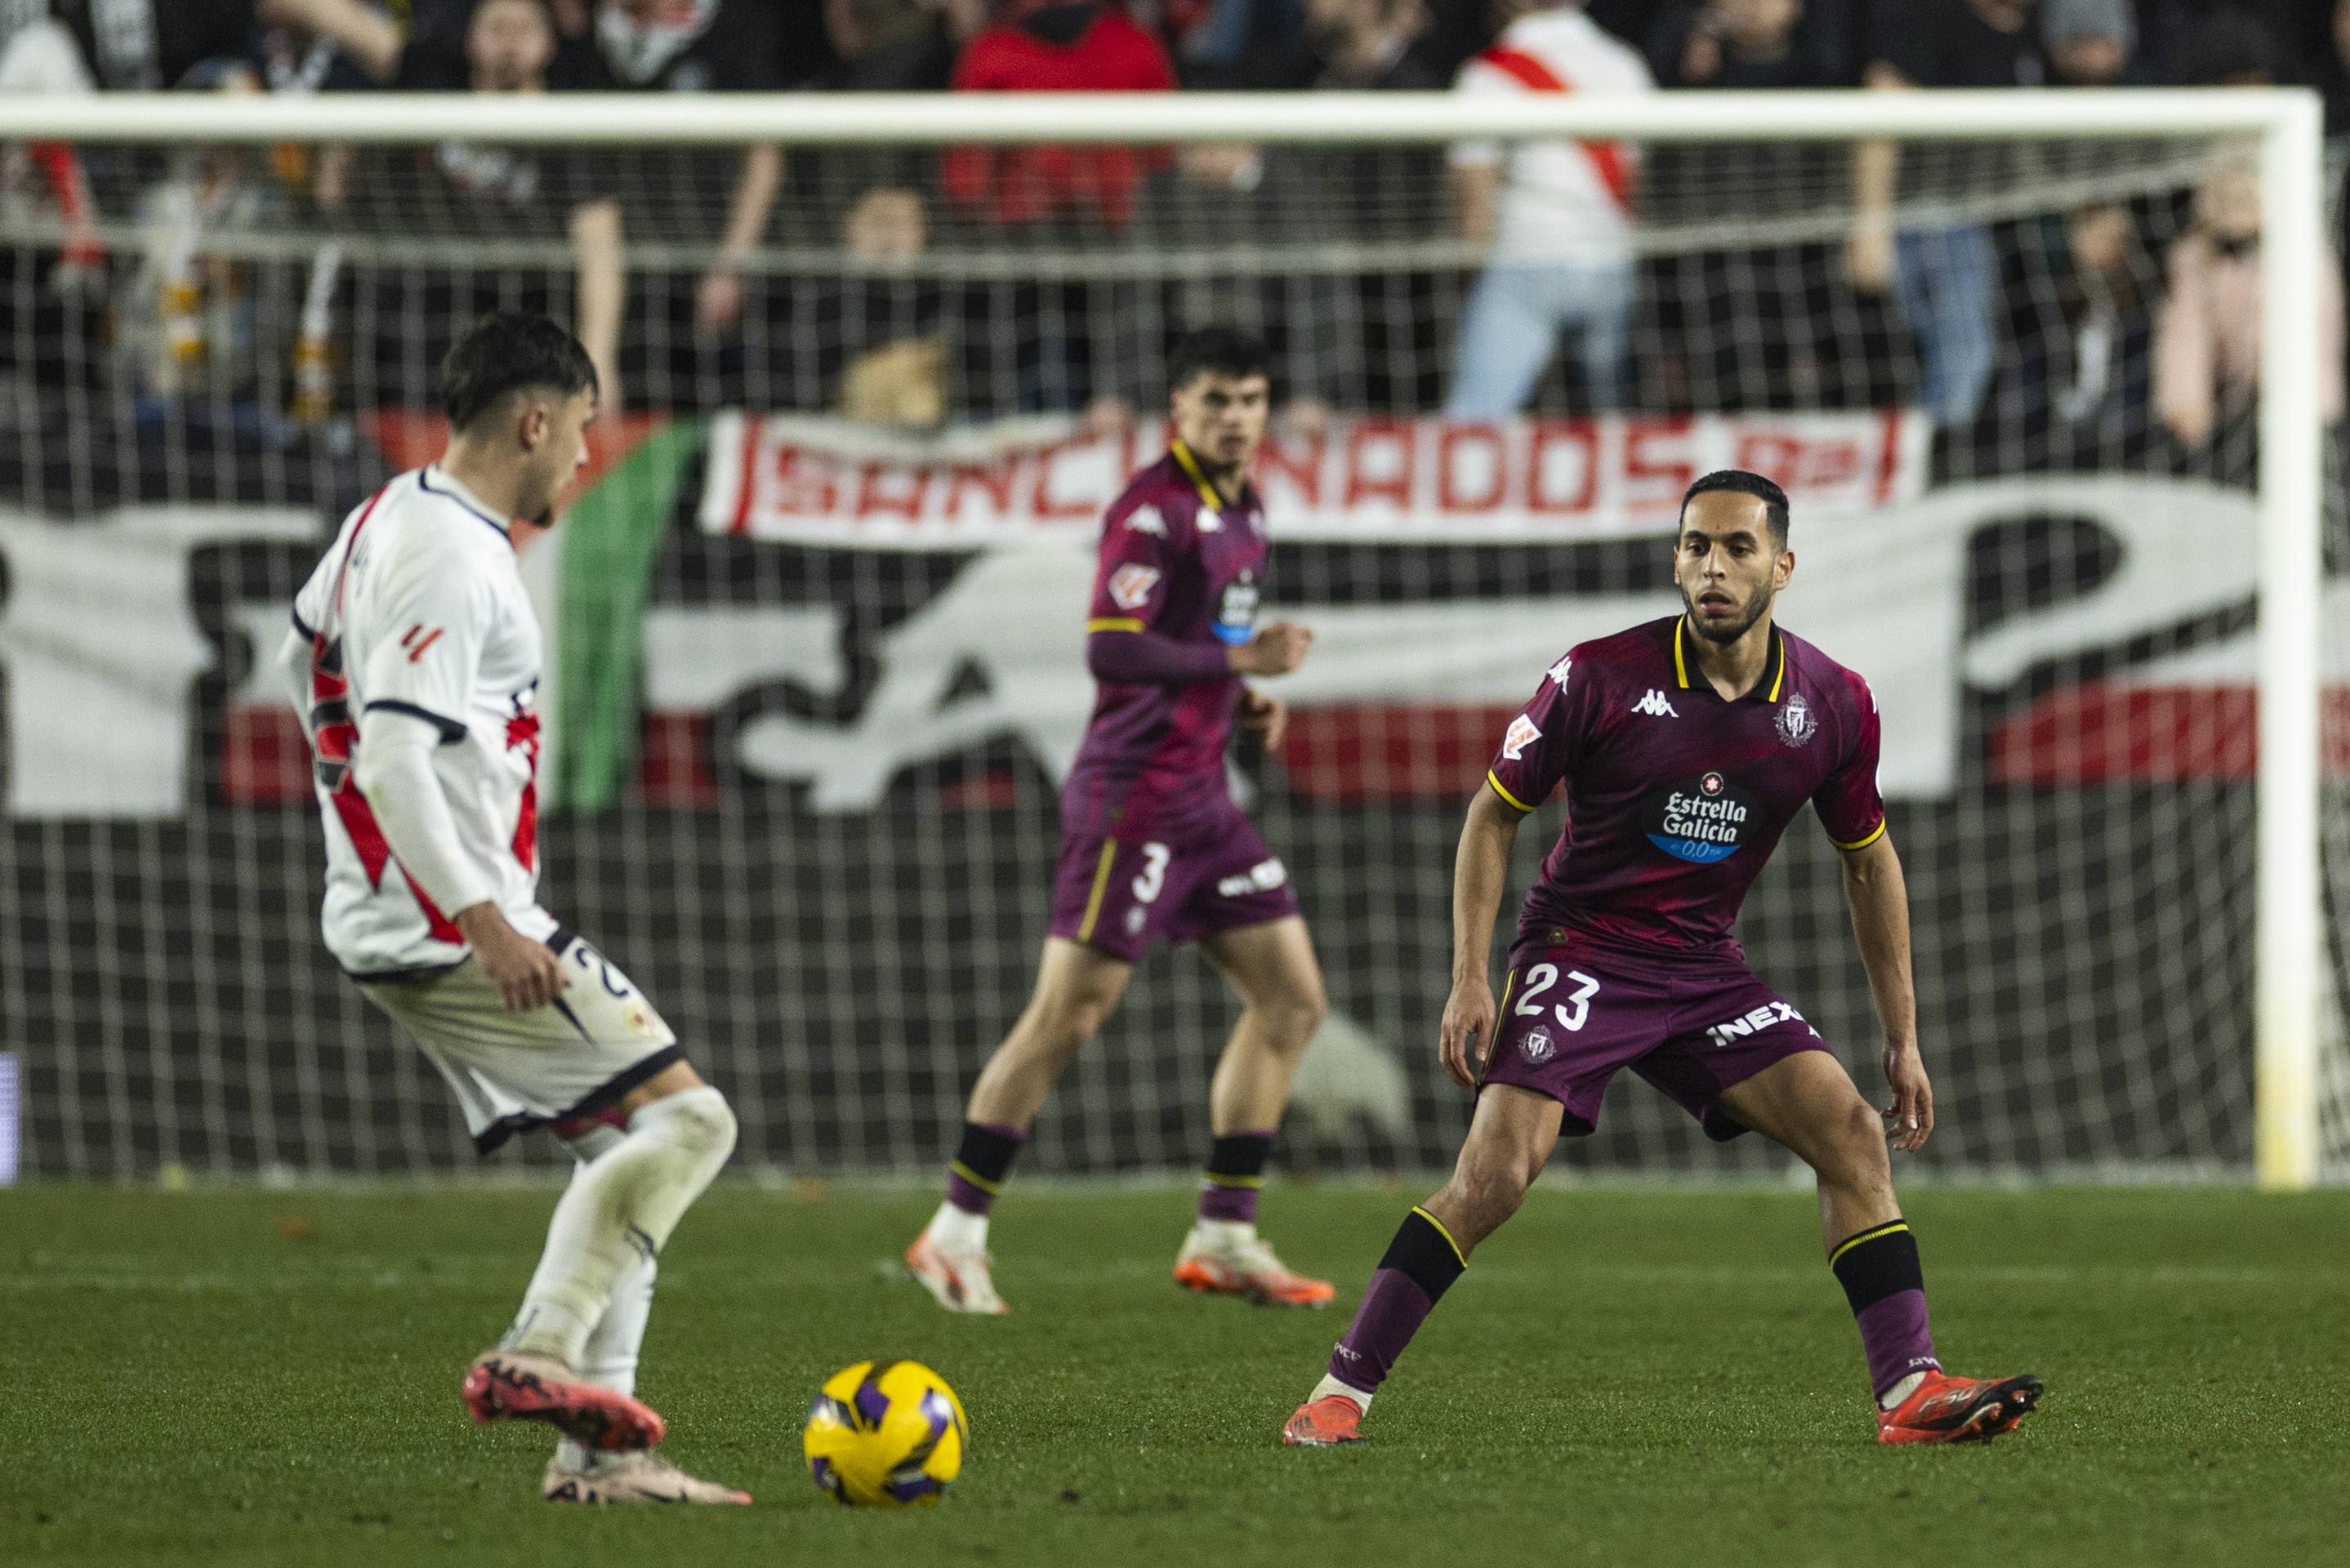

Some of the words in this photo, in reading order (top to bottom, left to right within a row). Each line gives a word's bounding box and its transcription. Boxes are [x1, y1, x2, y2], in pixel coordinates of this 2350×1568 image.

[1664, 792, 1747, 822] Estrella
[1663, 813, 1737, 842] Galicia
[1682, 840, 1710, 858] 0,0
[1131, 841, 1171, 903] 3
[1514, 963, 1600, 1031] 23
[1706, 1001, 1822, 1047] INEX
